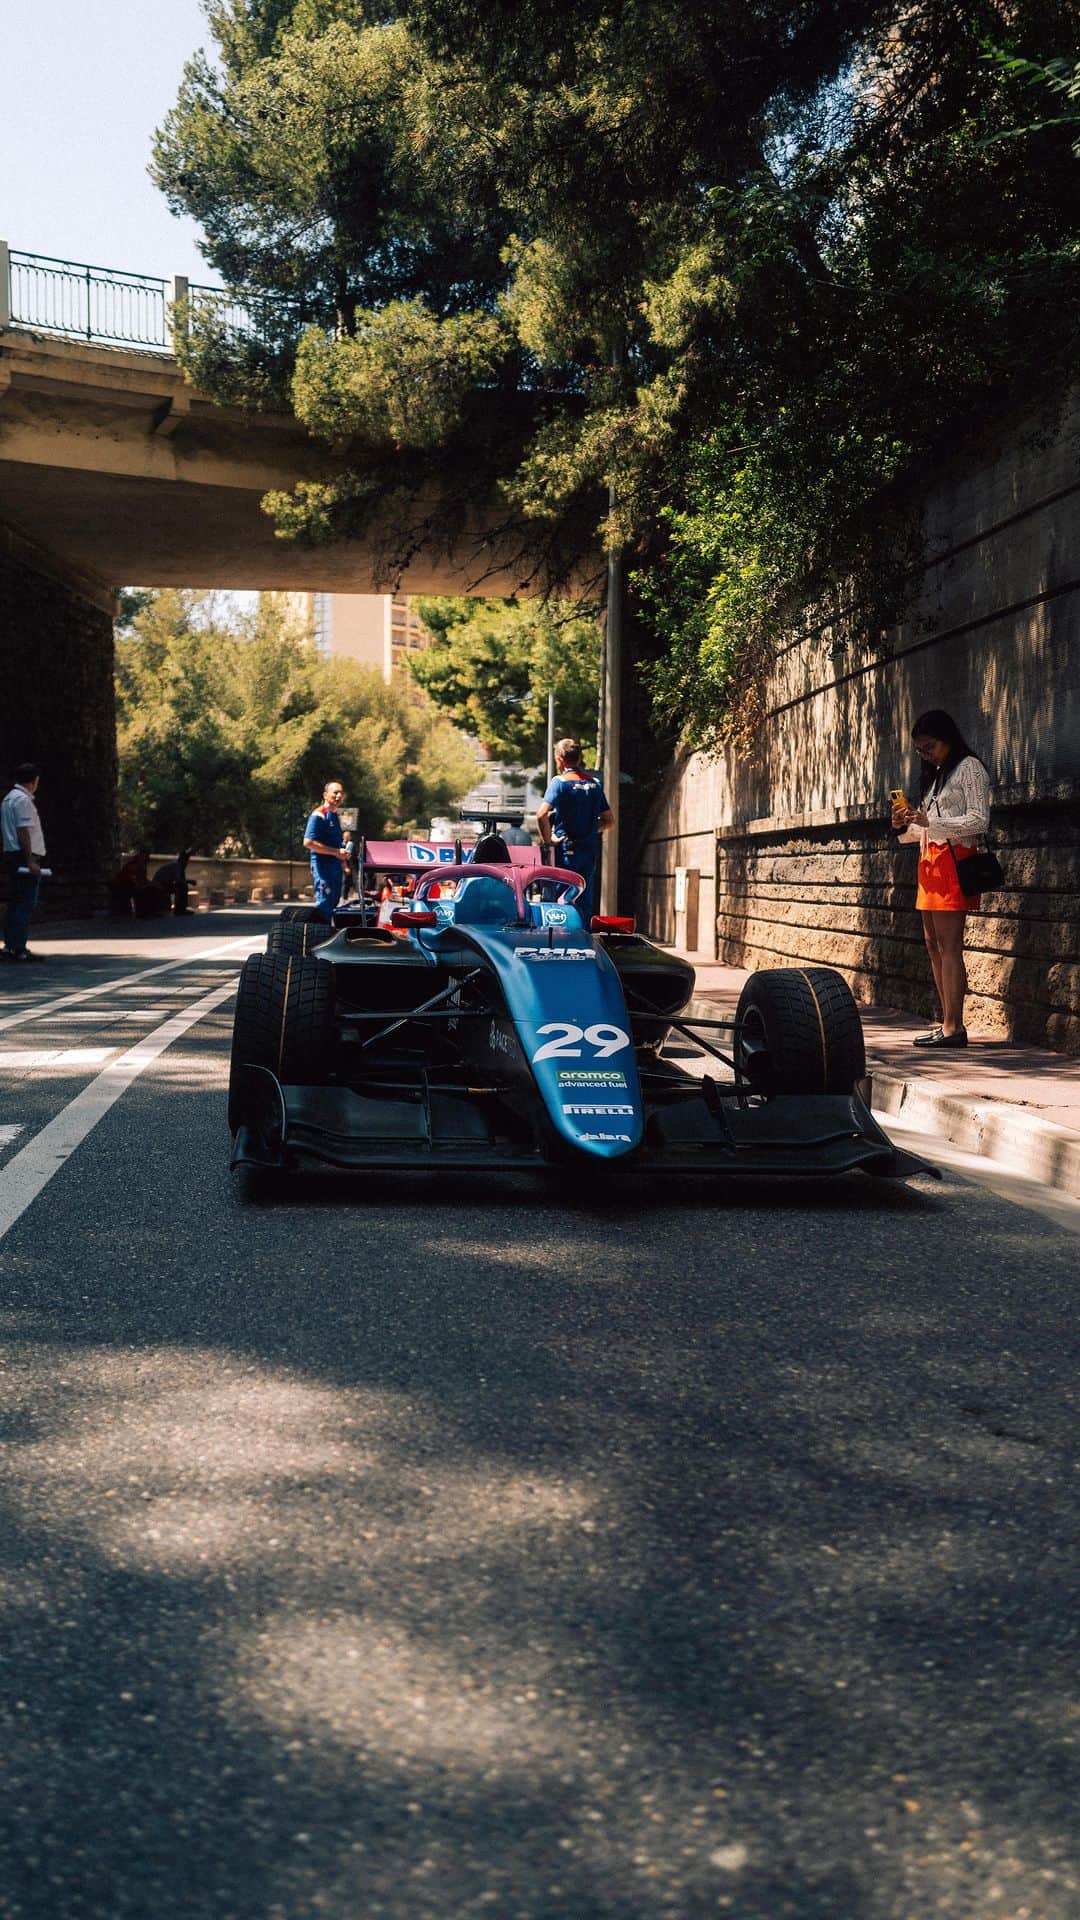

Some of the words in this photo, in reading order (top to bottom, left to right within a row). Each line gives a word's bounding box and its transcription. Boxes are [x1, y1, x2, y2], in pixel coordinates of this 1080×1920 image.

[532, 1022, 631, 1065] 29
[560, 1072, 622, 1080] aramco
[609, 1081, 628, 1089] fuel
[562, 1104, 634, 1116] PIRELLI
